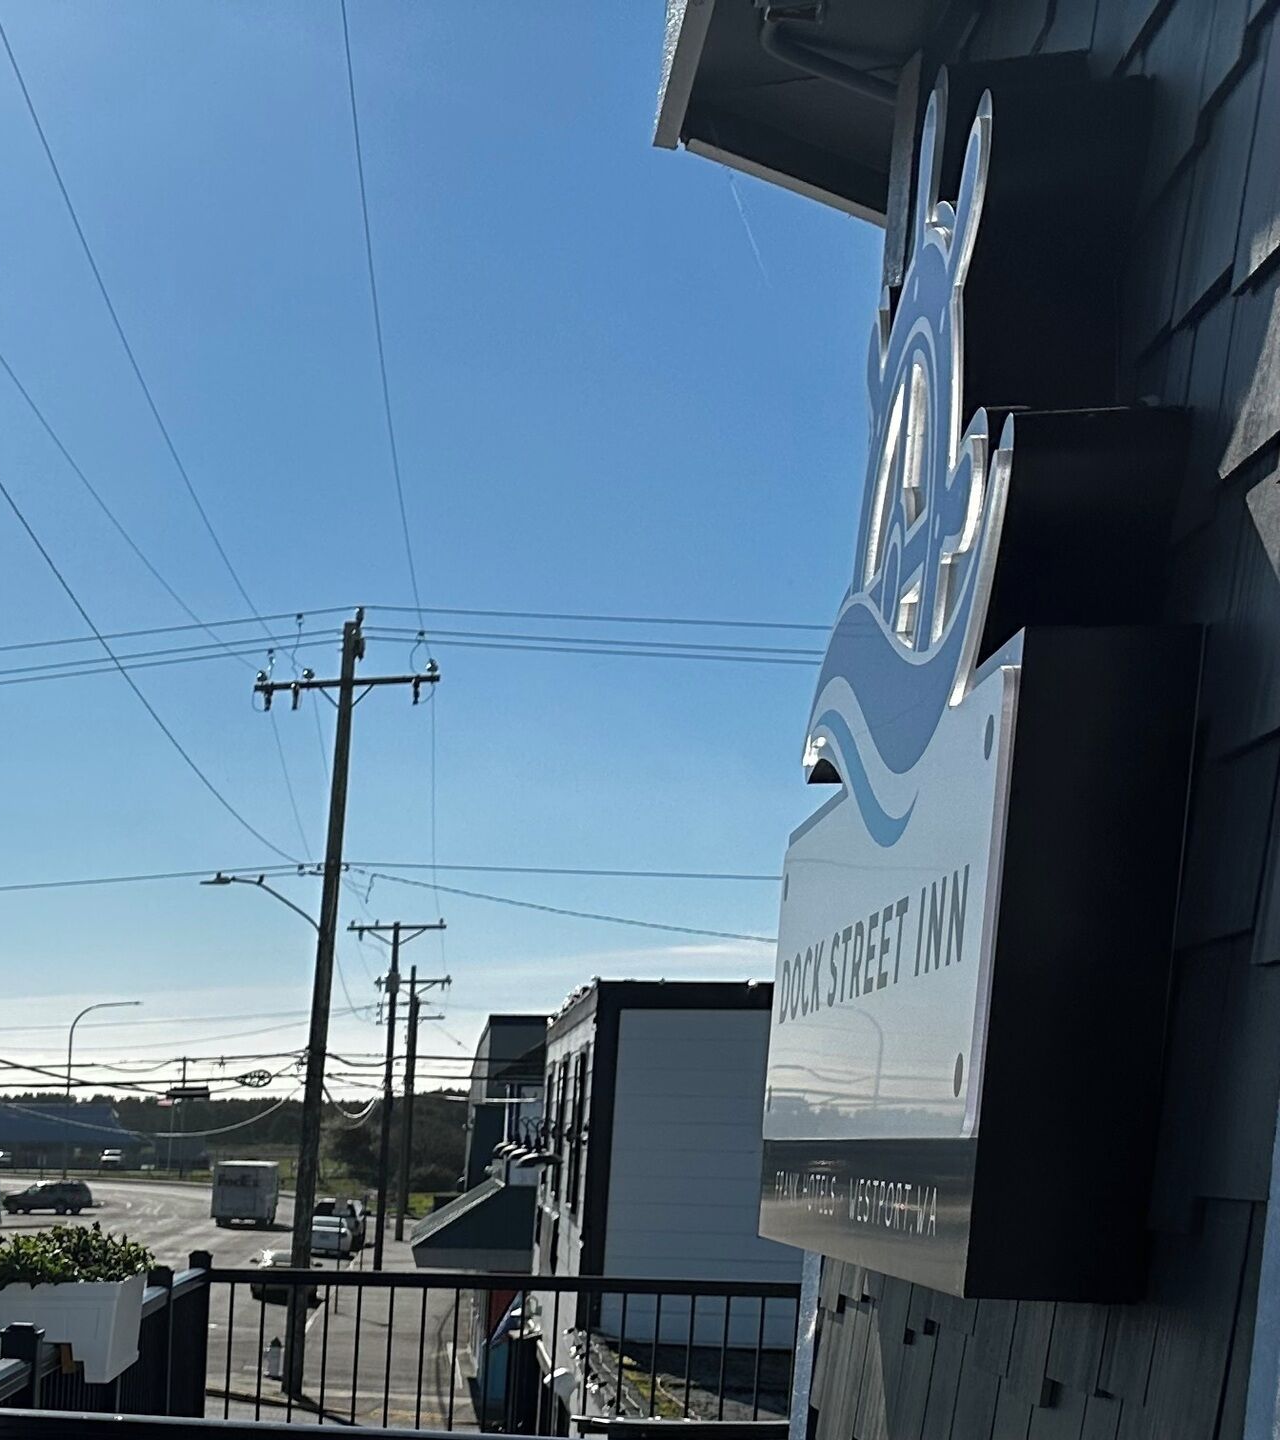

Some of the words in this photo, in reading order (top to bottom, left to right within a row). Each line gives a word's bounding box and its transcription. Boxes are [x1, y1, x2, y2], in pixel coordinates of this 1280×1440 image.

[778, 940, 825, 1025] DOCK
[827, 896, 910, 1008] STREET
[914, 863, 970, 977] INN
